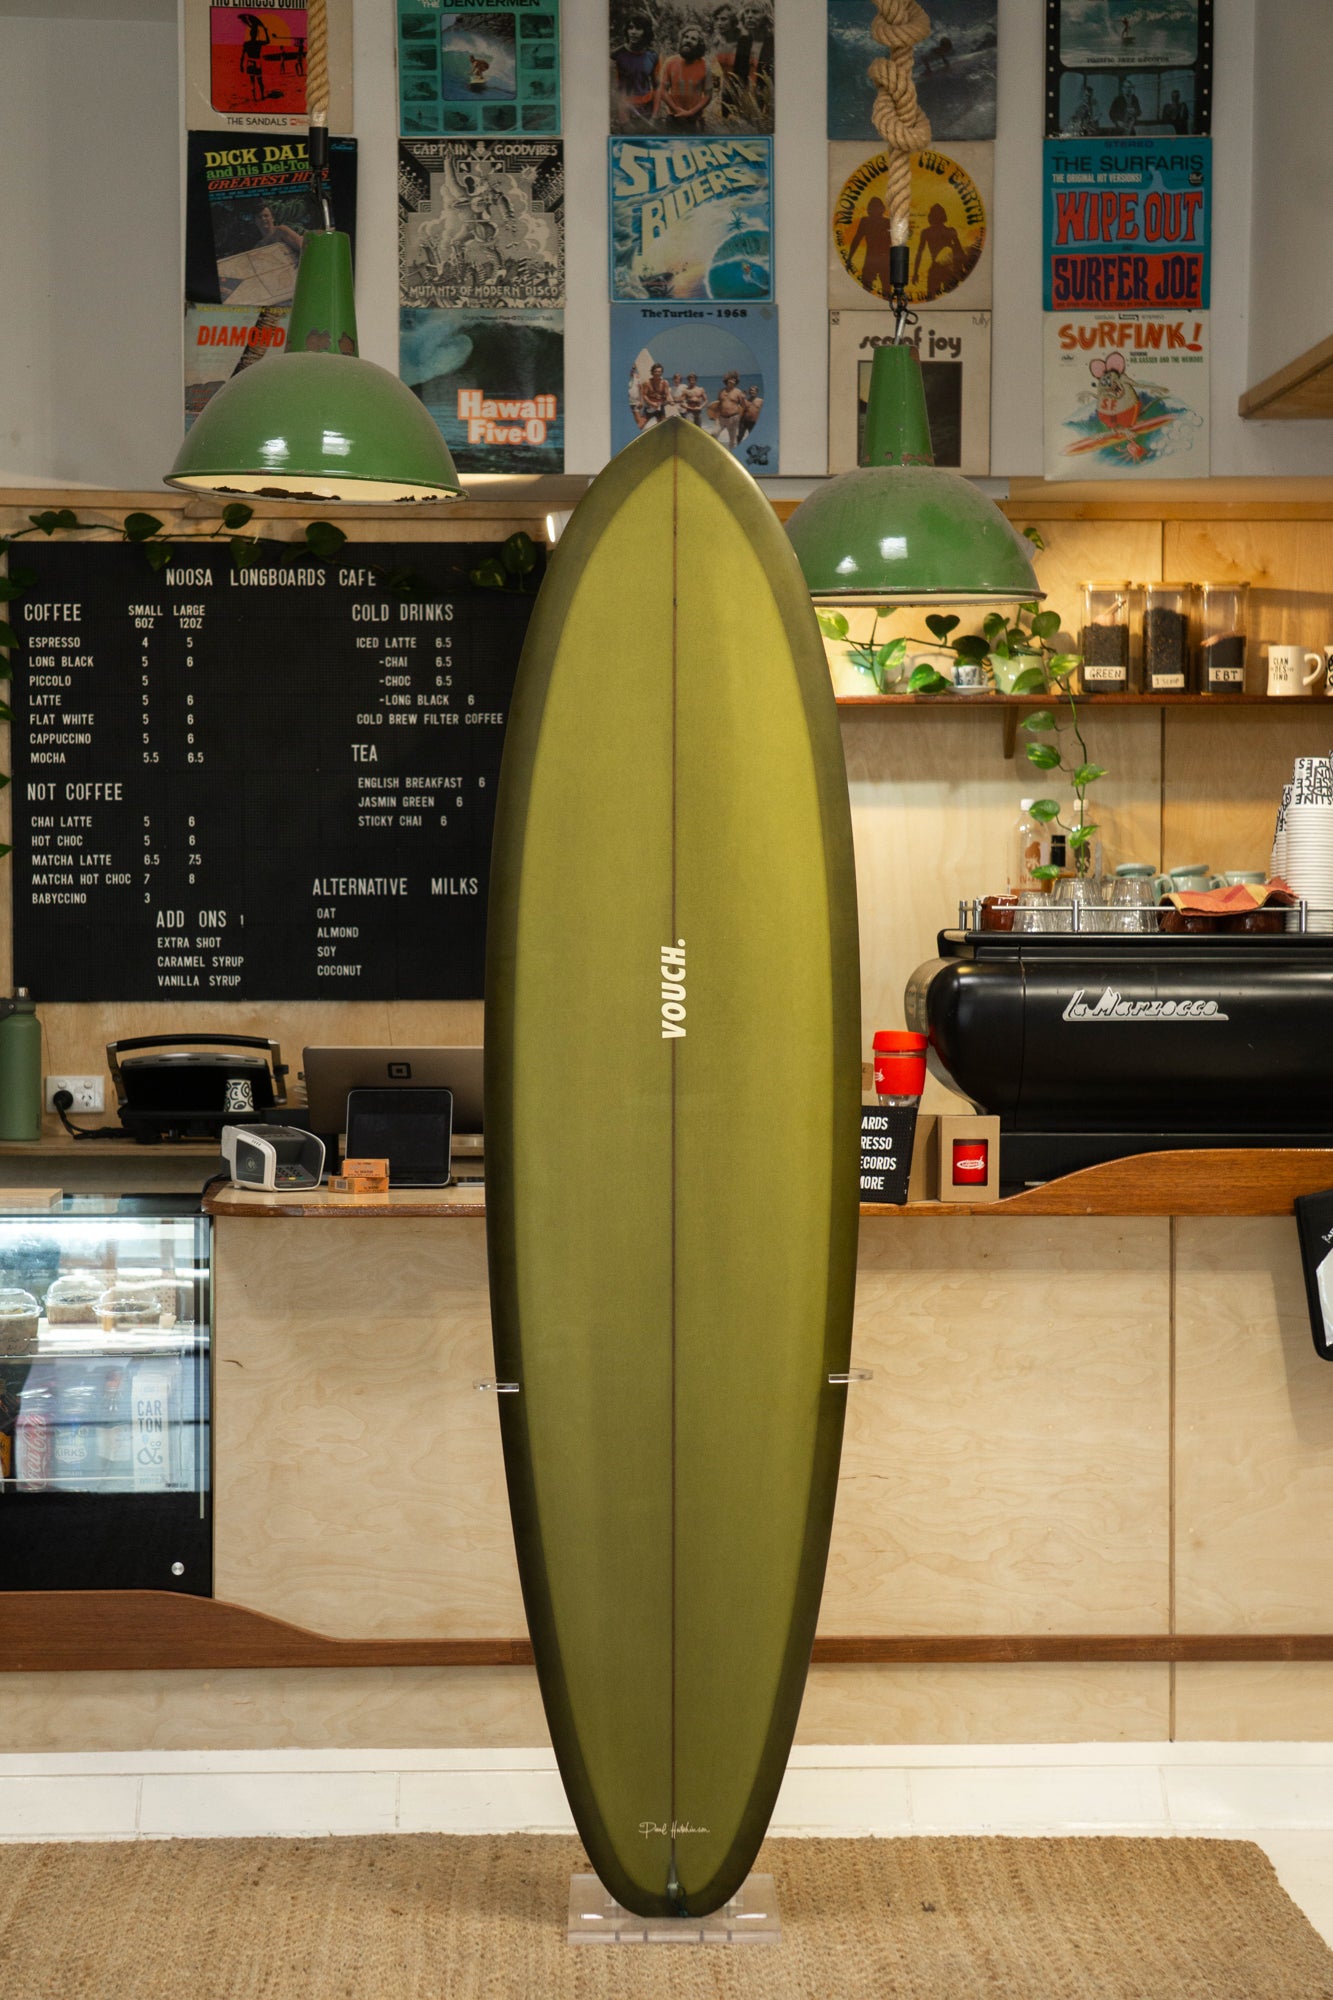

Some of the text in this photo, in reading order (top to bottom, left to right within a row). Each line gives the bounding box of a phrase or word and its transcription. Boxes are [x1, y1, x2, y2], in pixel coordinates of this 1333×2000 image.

[226, 117, 244, 126] THE
[246, 117, 288, 126] SANDALS
[412, 143, 558, 157] CAPTAIN GOODVIBES
[1103, 140, 1154, 149] STEREO
[204, 143, 310, 168] DICK DAL
[615, 139, 765, 198] STORM
[1051, 155, 1204, 172] THE SURFARIS
[206, 164, 259, 180] and his
[1052, 173, 1064, 183] THE
[1097, 173, 1107, 182] HIT
[208, 174, 289, 192] GREATEST
[836, 150, 985, 227] MORNING THE EARTH
[642, 166, 758, 255] RIDERS
[1055, 191, 1204, 246] WIPE OUT
[1055, 255, 1199, 302] SURFER JOE
[409, 286, 559, 298] MUTANTS OF MODERN DISCO
[716, 309, 749, 318] 1968
[197, 325, 286, 348] DIAMOND
[1058, 320, 1203, 352] SURFINK!
[928, 329, 962, 359] joy
[459, 391, 557, 420] Hawaii
[470, 420, 547, 445] Five-O
[167, 568, 377, 587] NOOSA LONGBOARDS CAFE
[25, 603, 83, 622] COFFEE
[129, 604, 165, 617] SMALL
[174, 604, 207, 616] LARGE
[352, 603, 455, 622] COLD DRINKS
[29, 636, 195, 649] ESPRESSO 4 5
[357, 636, 453, 649] ICED LATTE 6.5
[29, 655, 195, 668] LONG BLACK 5 6
[436, 656, 453, 668] 6.5
[30, 674, 150, 687] PICCOLO 5
[1089, 669, 1122, 679] GREEN
[1215, 670, 1238, 682] EBT
[436, 675, 454, 687] 6.5
[30, 694, 195, 706] LATTE 5 6
[418, 694, 451, 706] BLACK
[468, 694, 476, 706] 6
[30, 713, 195, 726] FLAT WHITE 5 6
[357, 712, 504, 725] COLD BREW FILTER COFFEE
[30, 732, 196, 745] CAPPUCCINO 5 6
[31, 751, 205, 764] MOCHA 5.5 6.5
[351, 743, 379, 762] TEA
[358, 776, 487, 789] ENGLISH BREAKFAST 6
[28, 782, 124, 801] NOT COFFEE
[359, 796, 464, 808] JASMIN GREEN 6
[32, 815, 197, 828] CHAI LATTE 5 6
[359, 815, 449, 827] STICKY CHAI 6
[32, 834, 197, 847] HOT CHOC 5 6
[32, 853, 203, 866] MATCHA LATTE 6.5 7.5
[32, 873, 197, 885] MATCHA HOT CHOC 7 8
[313, 877, 479, 896] ALTERNATIVE MILKS
[32, 892, 152, 905] BABYCCINO 3
[156, 909, 186, 928] ADD
[199, 909, 228, 928] ONS
[317, 907, 338, 919] OAT
[318, 926, 360, 938] ALMOND
[158, 936, 223, 949] EXTRA SHOT
[318, 945, 338, 958] SOY
[158, 955, 246, 968] CARAMEL SYRUP
[317, 964, 363, 977] COCONUT
[158, 975, 243, 987] VANILLA SYRUP
[660, 938, 687, 1039] VOUCH.
[861, 1116, 889, 1130] ARDS
[860, 1135, 893, 1150] RESSO
[860, 1156, 897, 1171] CORDS
[137, 1399, 162, 1417] CAR
[137, 1417, 163, 1433] TON
